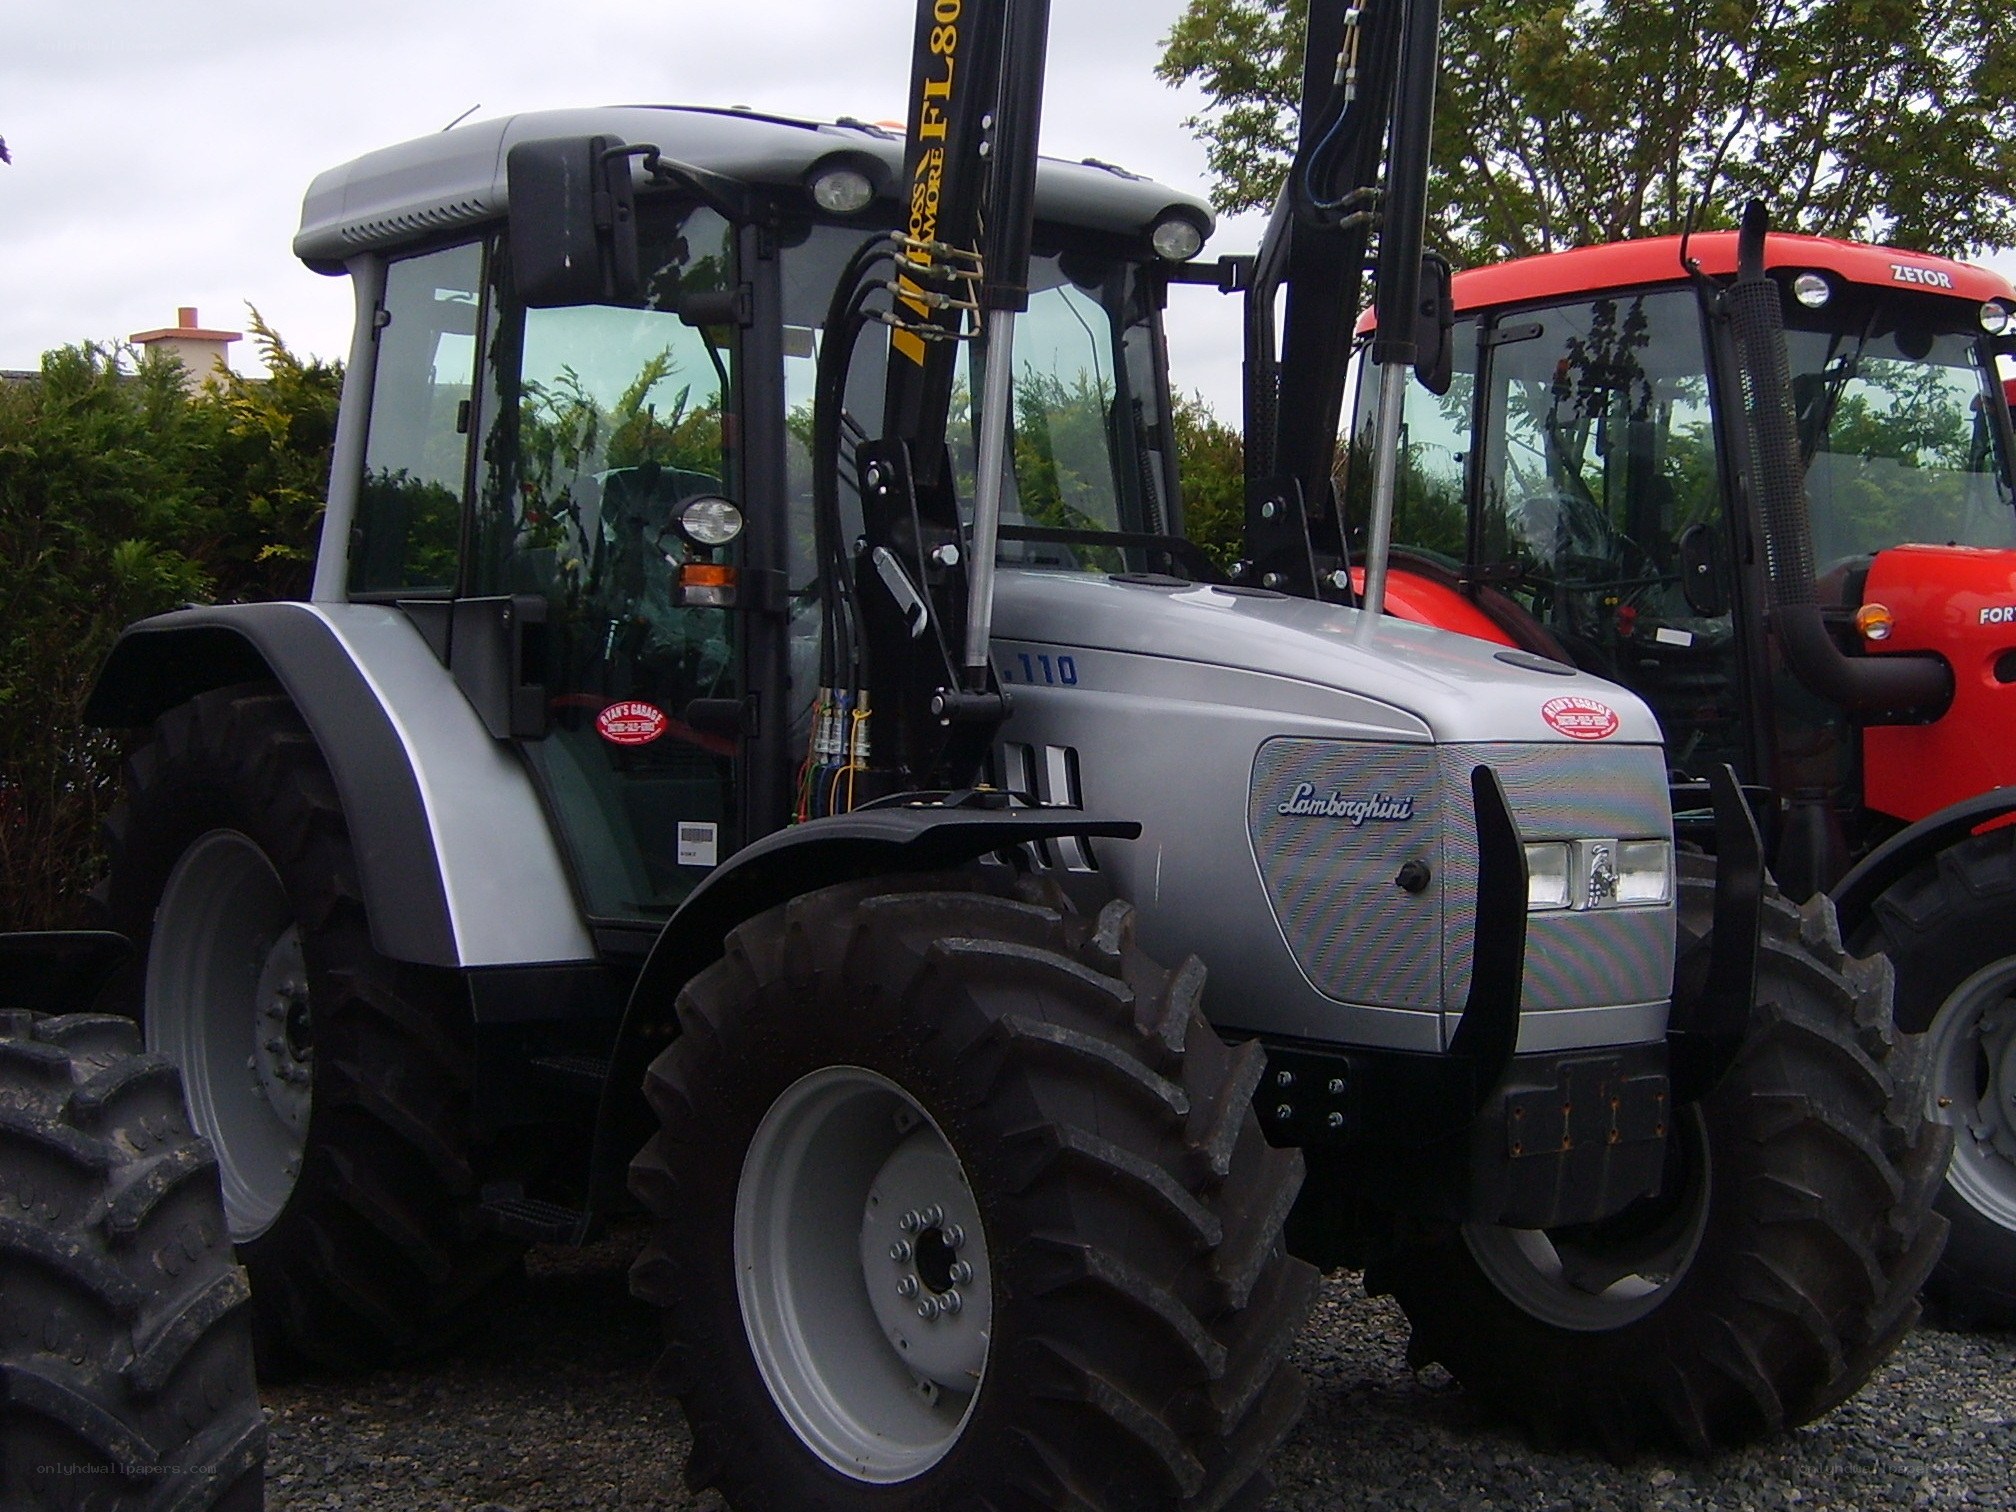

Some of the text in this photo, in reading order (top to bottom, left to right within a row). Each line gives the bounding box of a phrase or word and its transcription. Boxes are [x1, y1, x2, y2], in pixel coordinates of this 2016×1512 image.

[1890, 264, 1953, 289] ZETOR
[1979, 606, 2016, 625] FOR
[1278, 782, 1412, 826] Lamborghini
